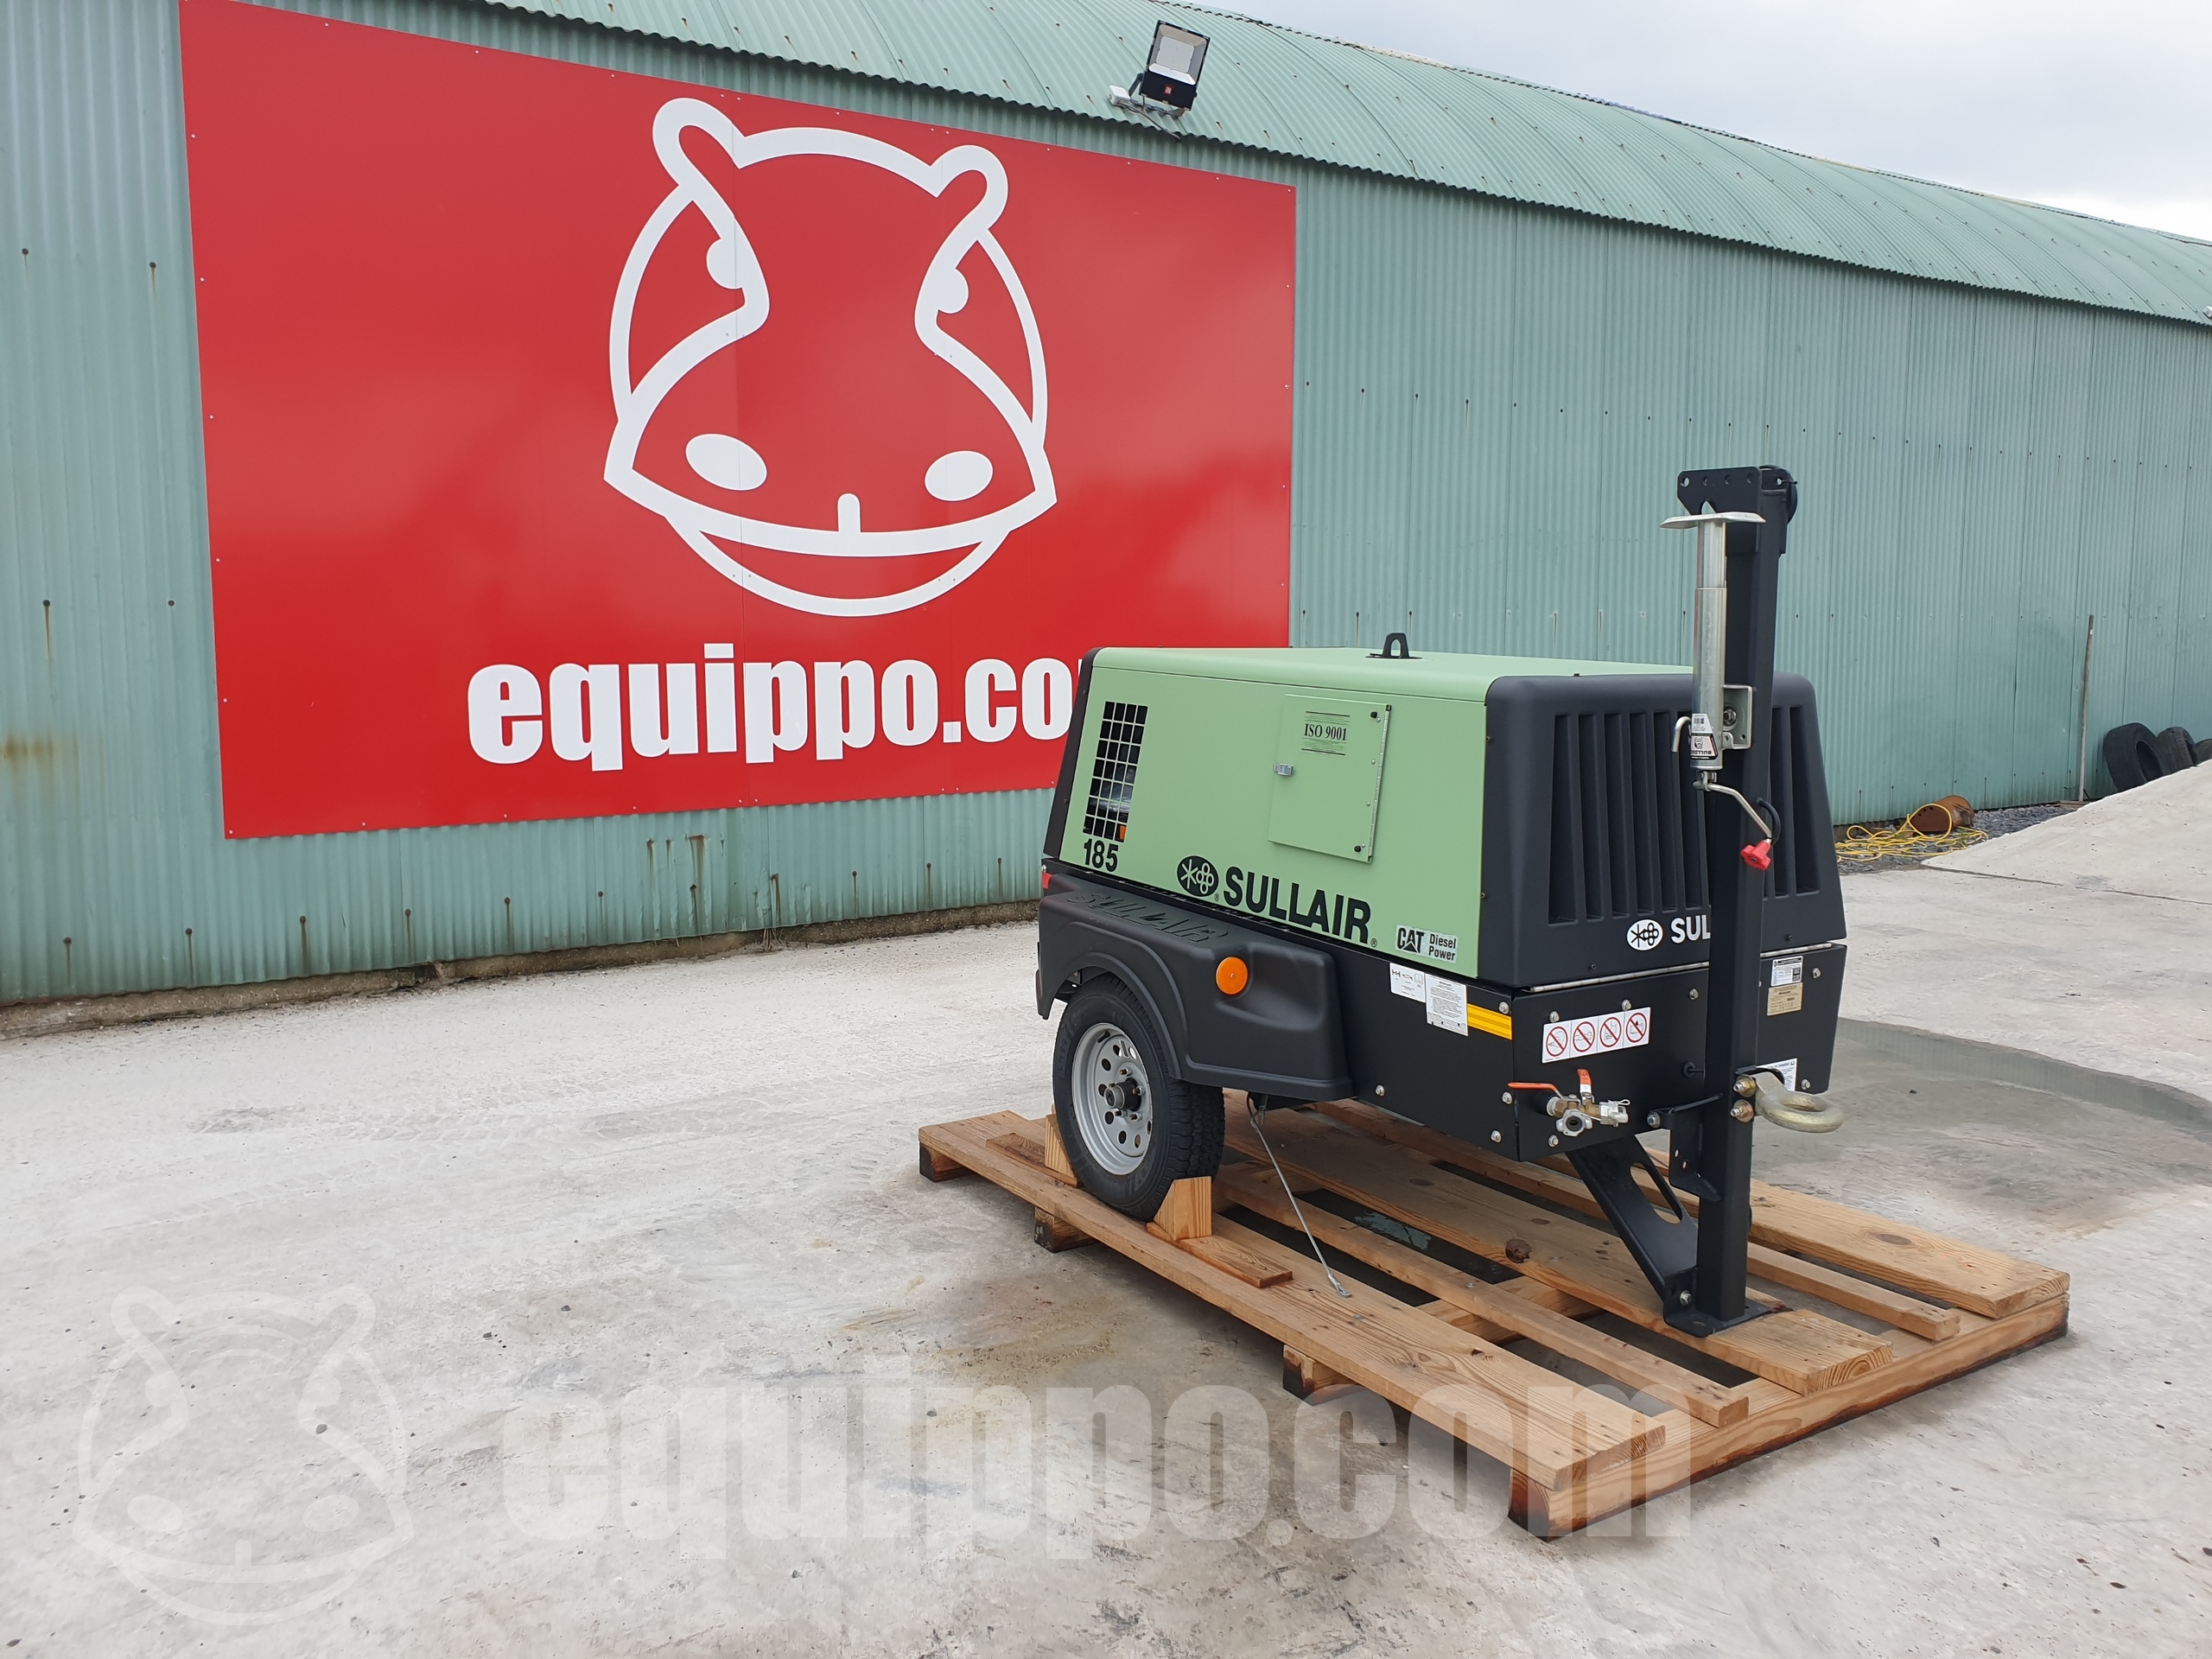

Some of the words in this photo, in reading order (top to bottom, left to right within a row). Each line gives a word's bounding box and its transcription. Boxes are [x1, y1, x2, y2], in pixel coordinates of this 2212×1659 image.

[467, 643, 1082, 772] equippo.co
[1304, 723, 1323, 738] ISO
[1325, 726, 1347, 741] 9001
[1084, 838, 1118, 873] 185
[1224, 866, 1371, 944] SULLAIR
[1397, 927, 1425, 953] CAT
[1428, 945, 1455, 961] Power
[1429, 933, 1457, 949] Diesel
